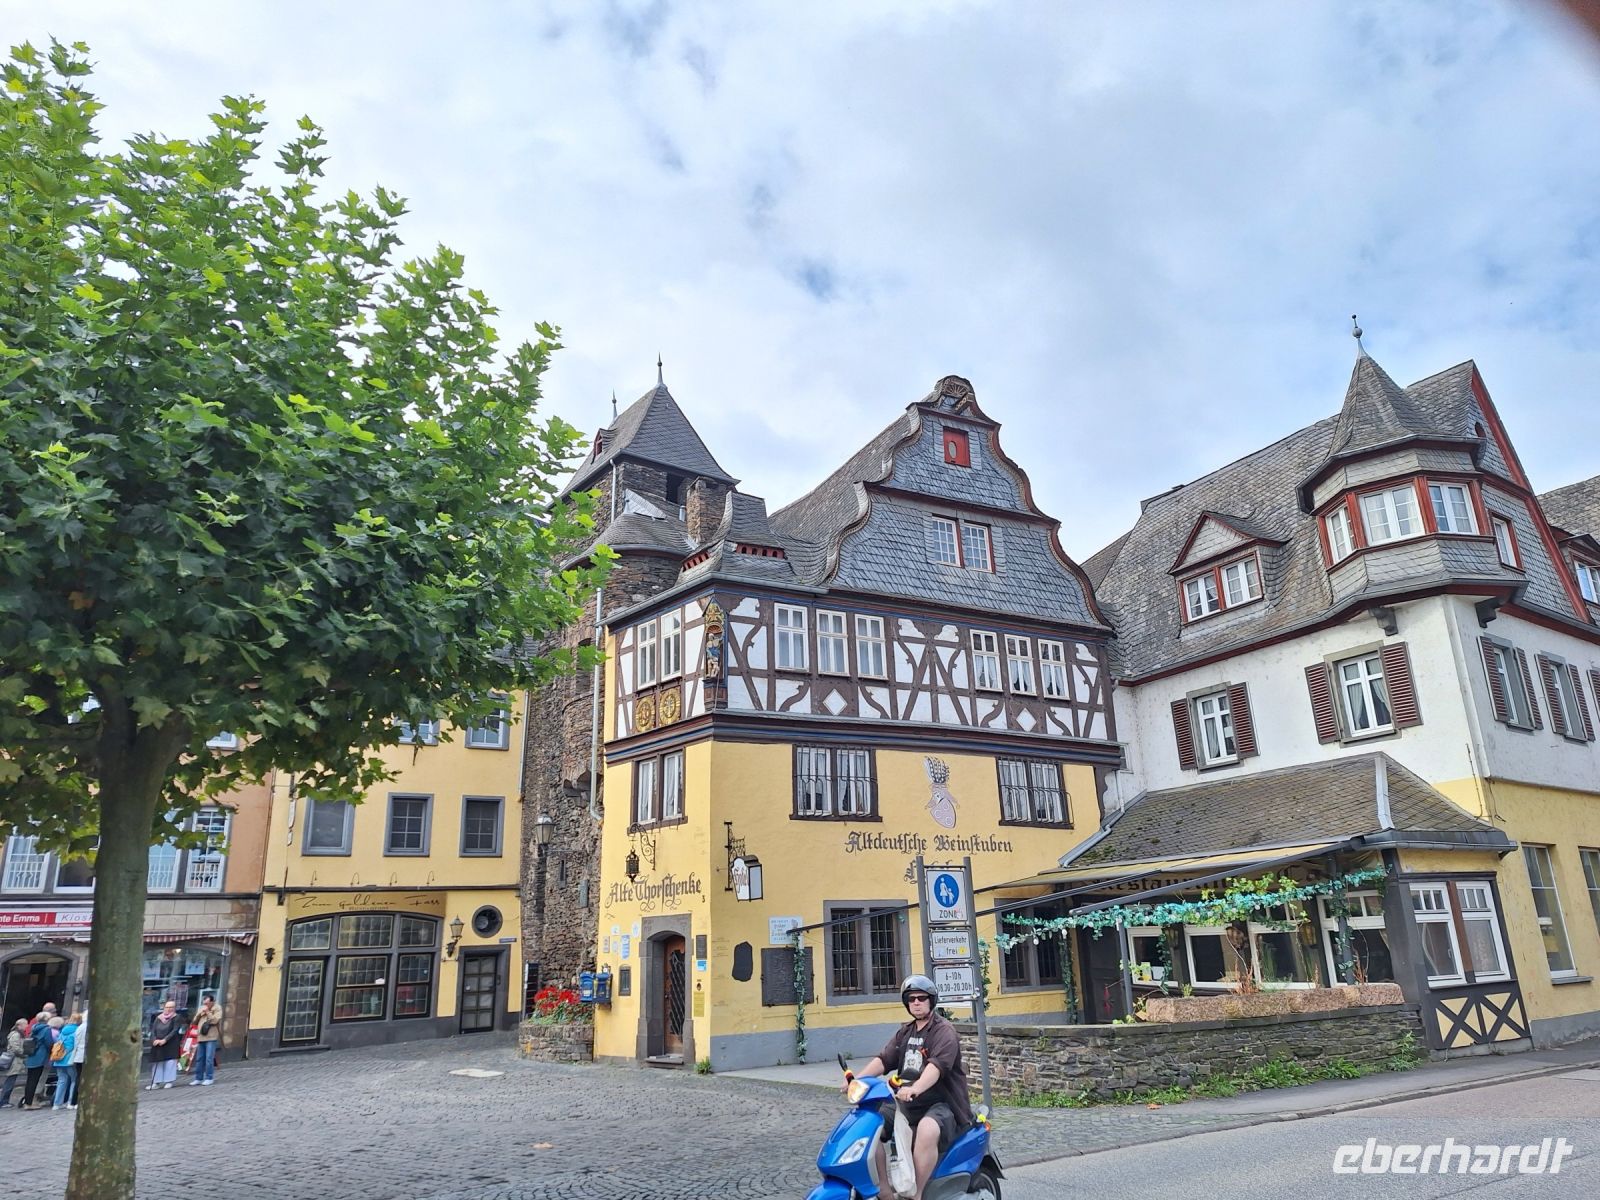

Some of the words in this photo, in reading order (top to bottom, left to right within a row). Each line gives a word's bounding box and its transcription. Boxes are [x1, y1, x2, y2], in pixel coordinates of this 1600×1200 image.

[845, 831, 928, 855] Altdeutsche
[934, 834, 1013, 855] Weinstuben
[604, 881, 634, 908] Alte
[13, 914, 40, 922] Emma
[934, 935, 967, 944] Lieferverkehr
[946, 946, 958, 955] frei
